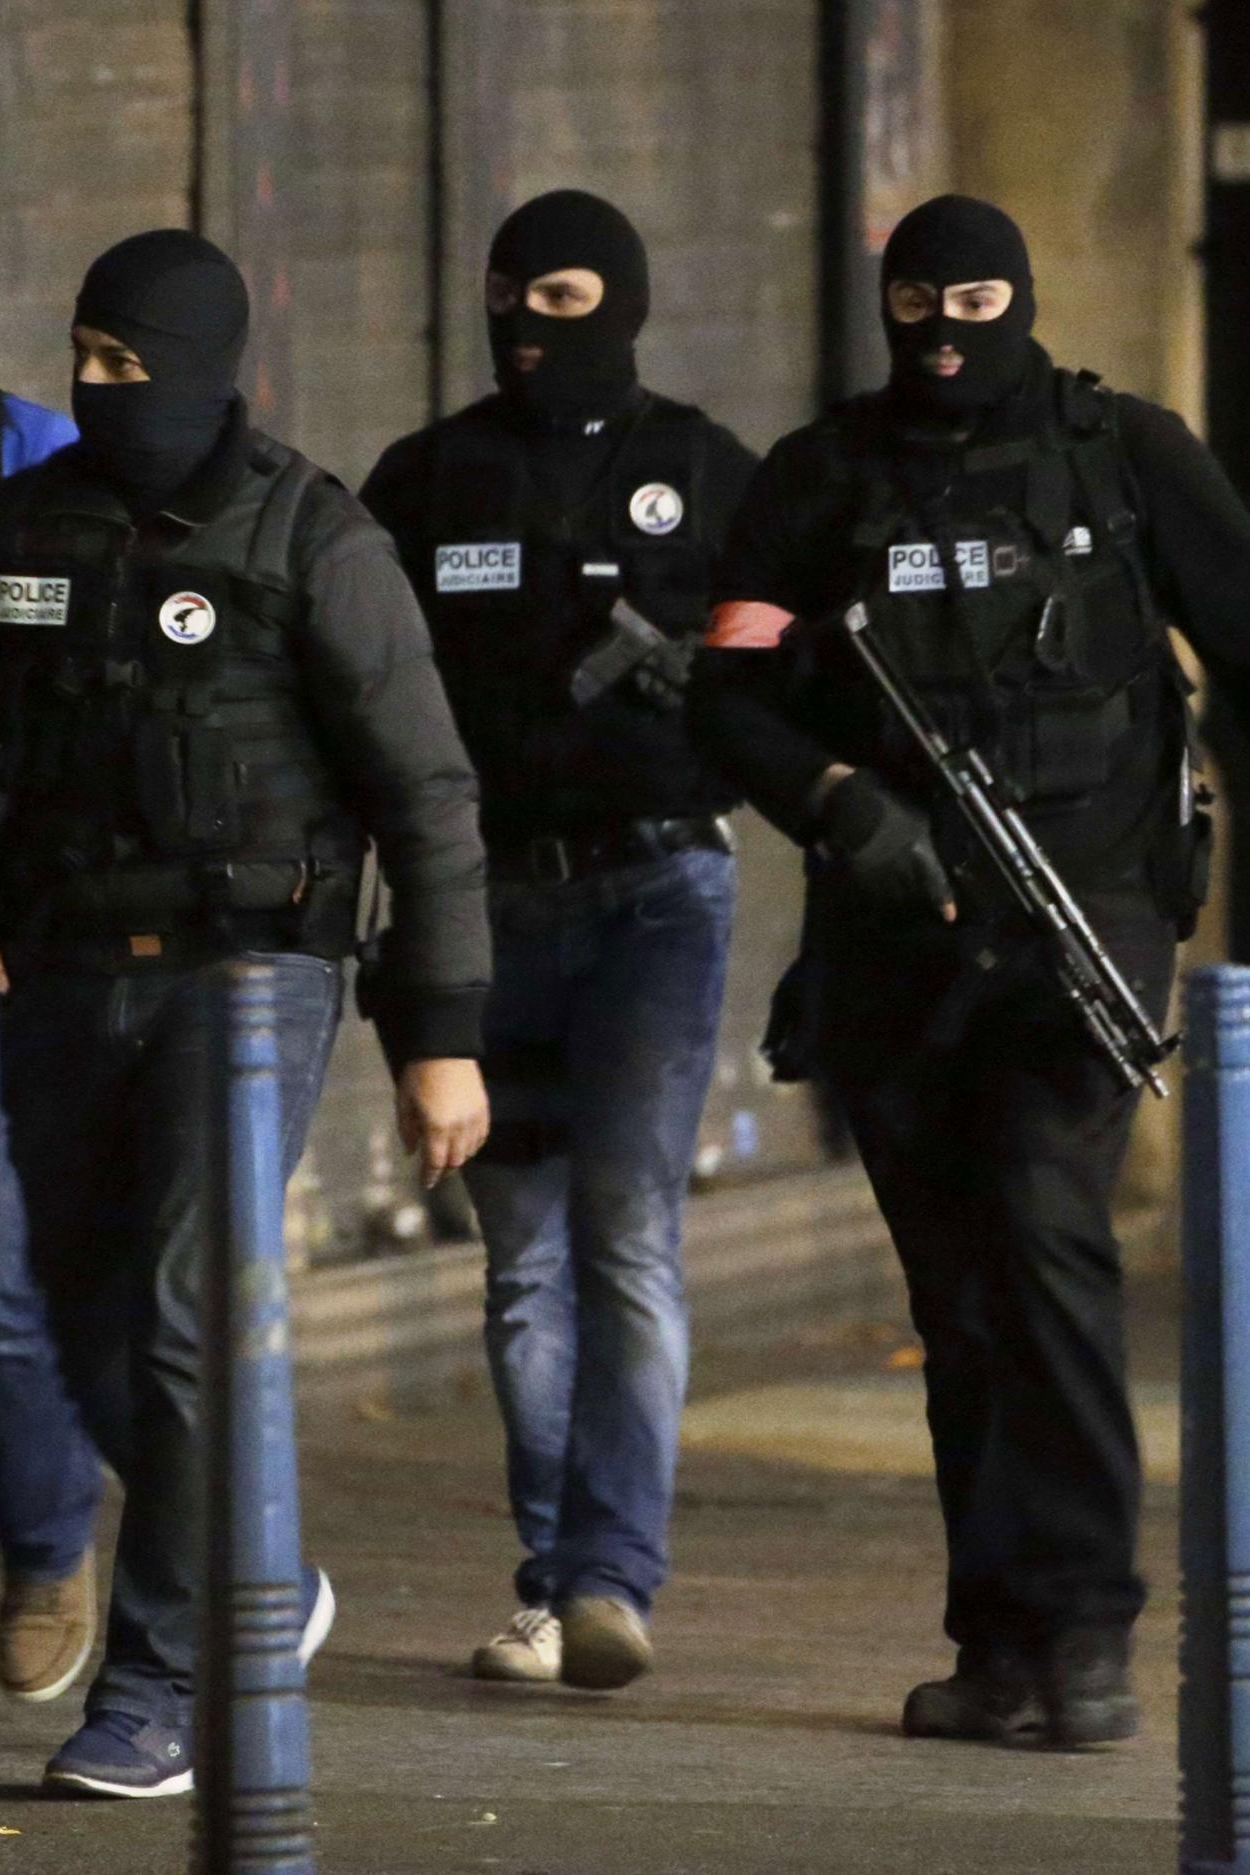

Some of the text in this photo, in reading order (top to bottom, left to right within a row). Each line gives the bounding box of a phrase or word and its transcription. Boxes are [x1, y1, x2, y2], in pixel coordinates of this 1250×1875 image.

[437, 548, 516, 570] POLICE
[893, 545, 985, 569] POLCE
[894, 570, 985, 586] JUDICRE
